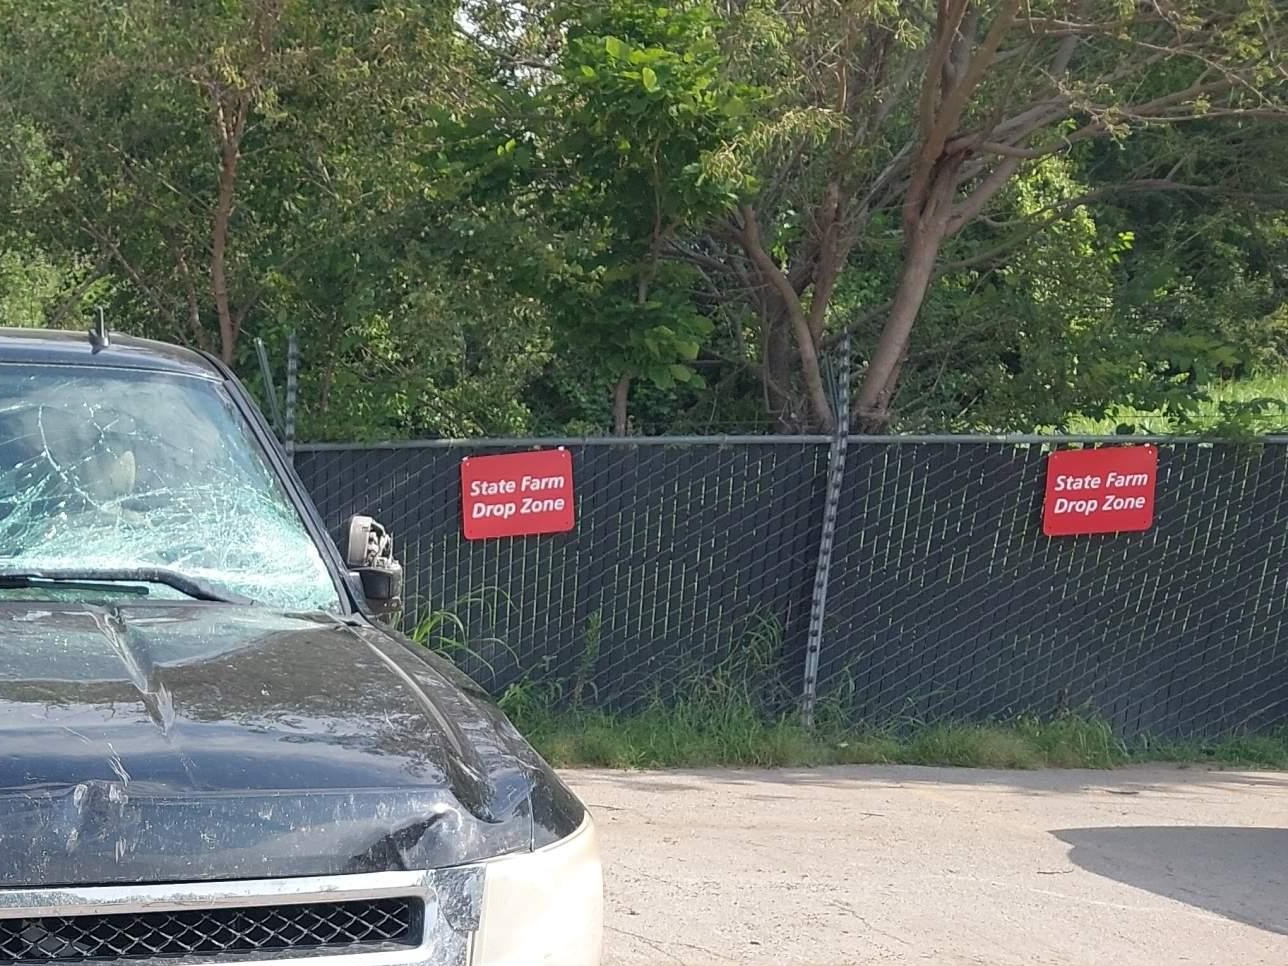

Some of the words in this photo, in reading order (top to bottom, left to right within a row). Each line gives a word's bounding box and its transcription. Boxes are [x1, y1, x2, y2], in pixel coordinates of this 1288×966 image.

[469, 480, 517, 497] State
[520, 475, 565, 492] Farm
[1054, 474, 1102, 492] State
[1105, 472, 1149, 488] Farm
[472, 502, 516, 520] Drop
[519, 498, 566, 514] Zone
[1053, 498, 1098, 516] Drop
[1102, 495, 1146, 511] Zone
